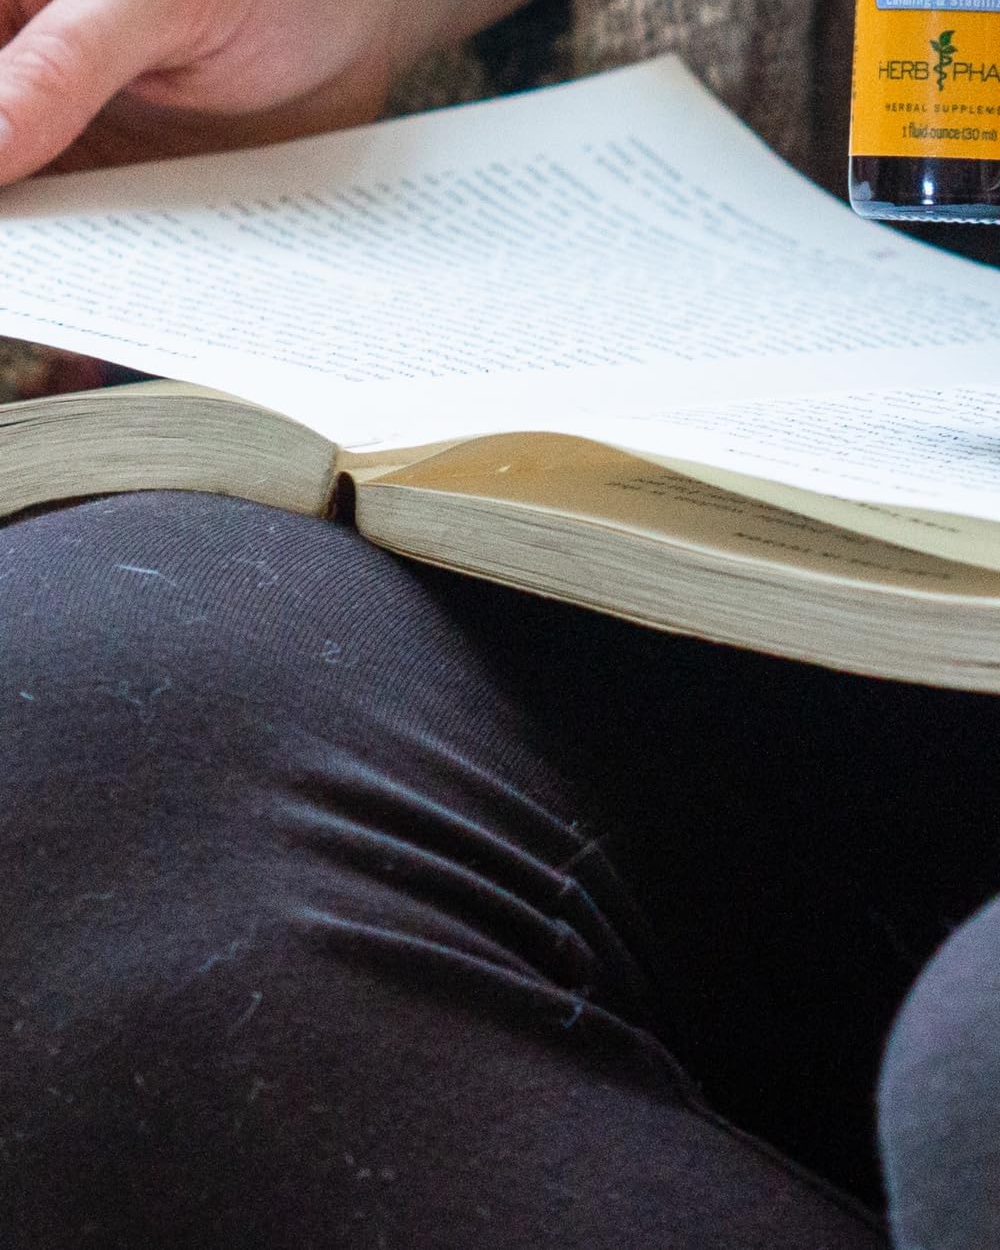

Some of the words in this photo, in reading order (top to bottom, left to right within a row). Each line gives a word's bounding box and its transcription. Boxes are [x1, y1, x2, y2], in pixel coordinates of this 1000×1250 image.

[878, 61, 929, 81] HERB
[885, 103, 928, 113] HERBAL
[908, 121, 928, 139] fluid
[929, 127, 961, 139] ounce
